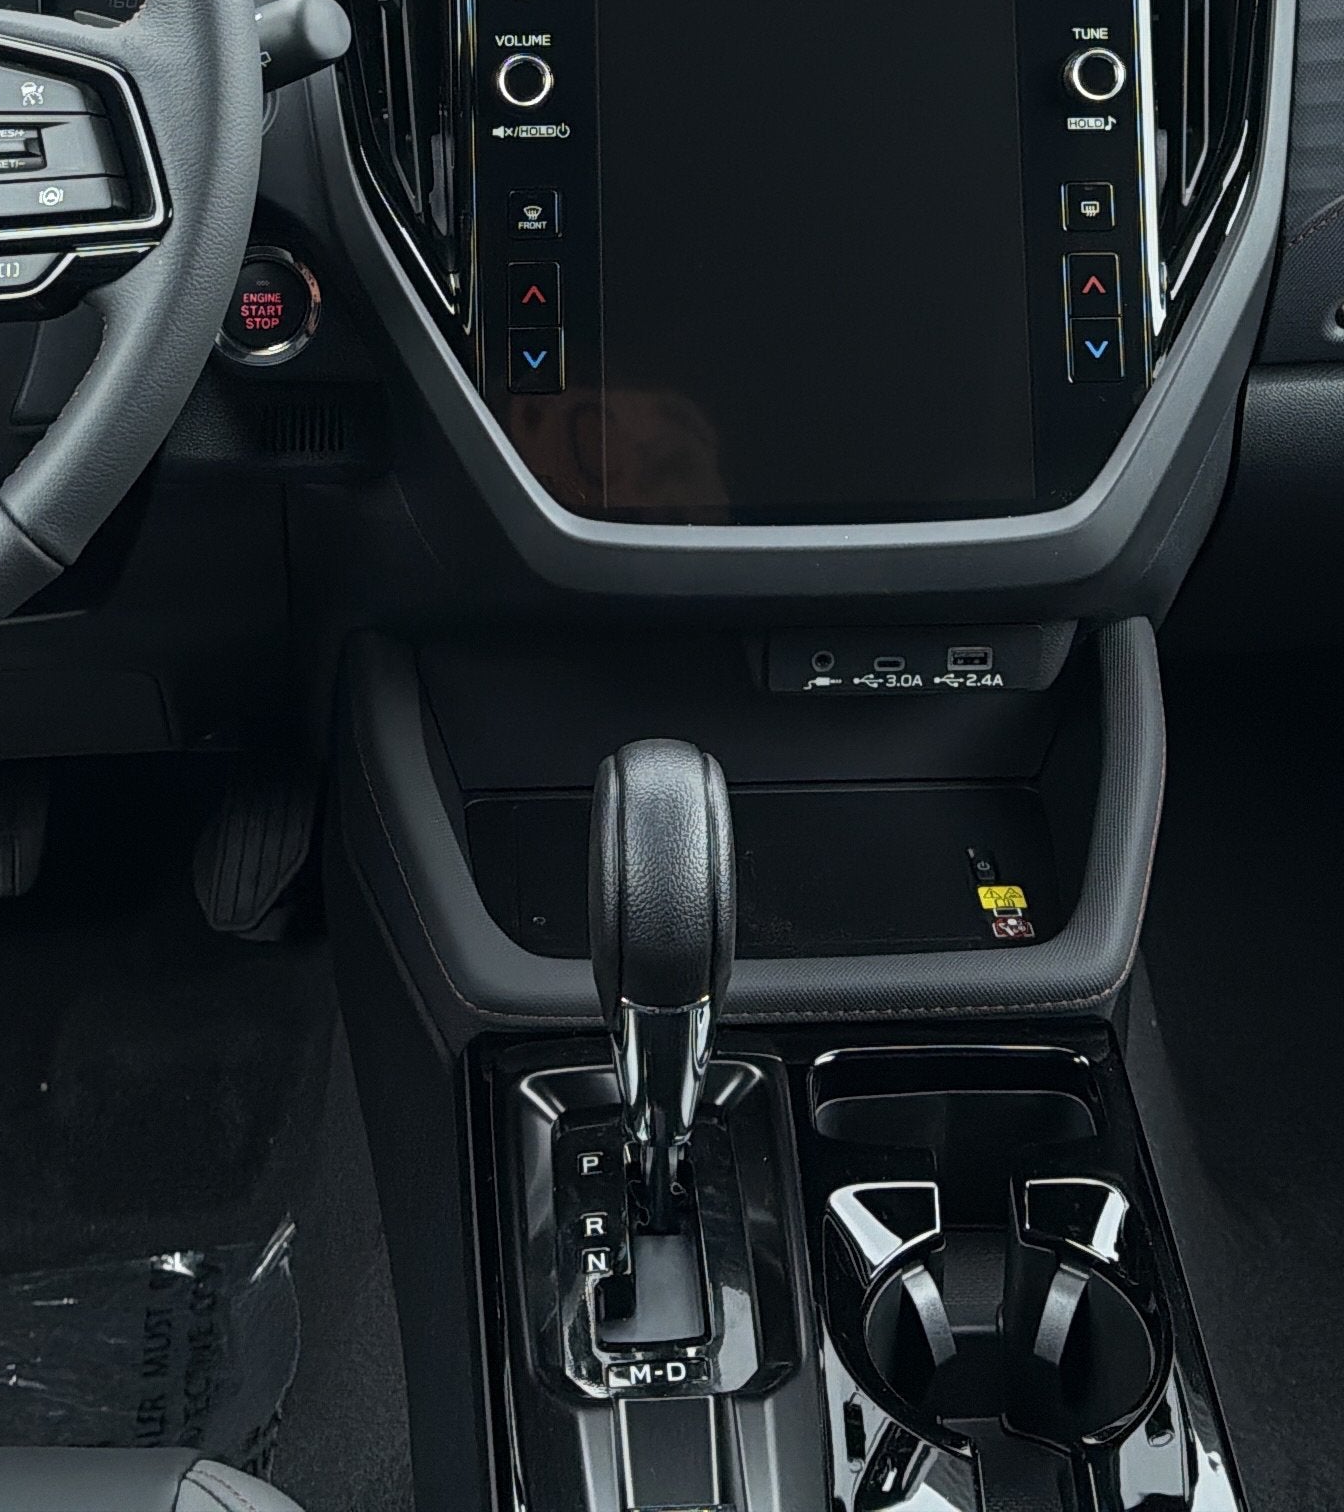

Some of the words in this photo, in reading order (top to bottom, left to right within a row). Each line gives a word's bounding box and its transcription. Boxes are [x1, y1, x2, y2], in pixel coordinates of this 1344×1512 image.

[494, 34, 552, 46] VOLUME
[1071, 27, 1109, 40] TUNE
[1068, 118, 1104, 129] HOLD
[520, 126, 556, 137] HOLD
[517, 221, 547, 230] FRONT
[242, 292, 282, 304] ENGINE
[240, 304, 284, 317] START
[244, 318, 279, 330] STOP
[885, 675, 923, 687] 3.0A
[966, 674, 1003, 687] 2.4A
[582, 1156, 599, 1173] P
[586, 1218, 604, 1236] R
[587, 1254, 606, 1272] N
[141, 1306, 173, 1377] MUST
[629, 1362, 686, 1384] M-D
